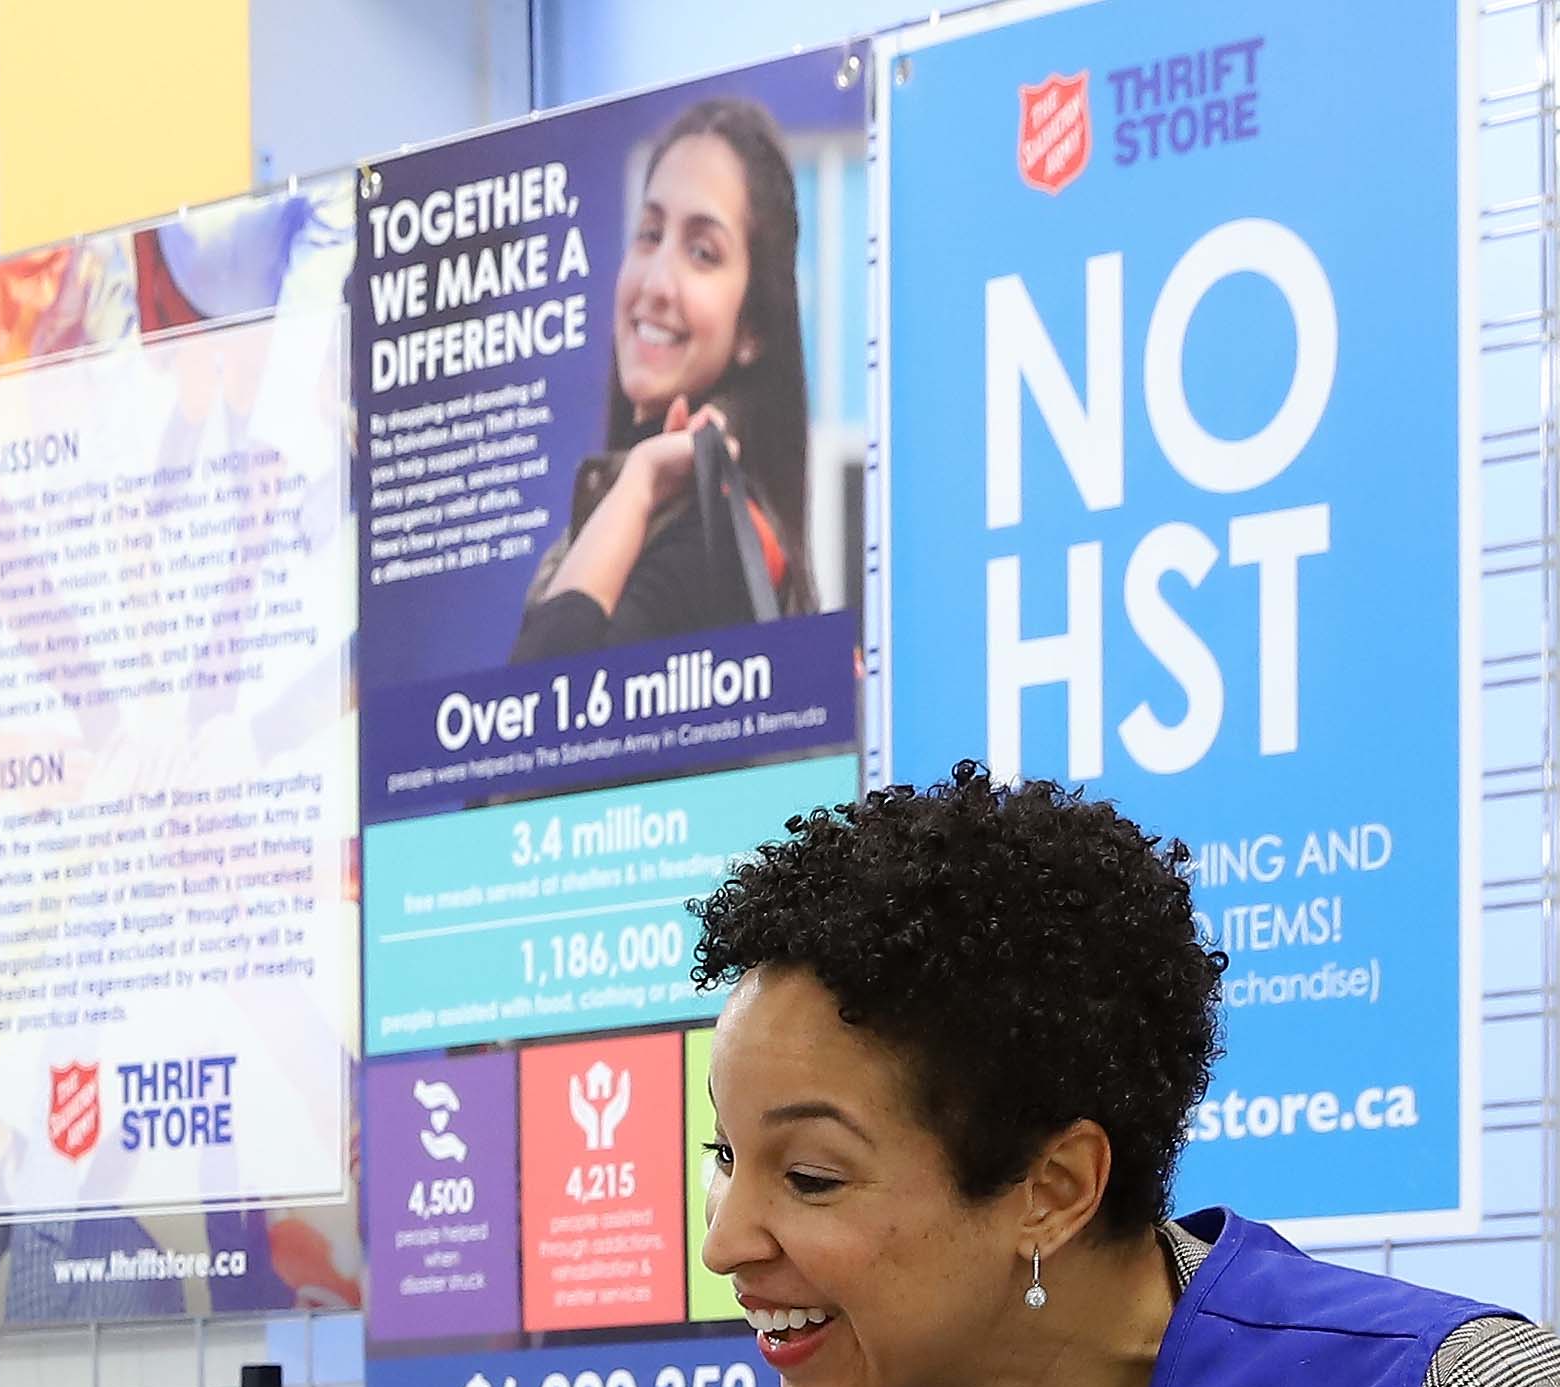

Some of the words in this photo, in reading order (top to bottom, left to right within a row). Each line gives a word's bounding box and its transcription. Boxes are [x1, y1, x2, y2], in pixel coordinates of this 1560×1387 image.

[1107, 36, 1264, 115] THRIFT
[1114, 92, 1261, 166] STORE
[369, 161, 579, 258] TOGETHER,
[370, 263, 428, 325] WE
[435, 236, 548, 311] MAKE
[558, 226, 589, 281] A
[370, 293, 587, 392] DIFFERENCE
[986, 217, 1338, 529] NO
[986, 502, 1330, 786] HST
[437, 686, 540, 752] Over
[551, 670, 613, 734] 1.6
[625, 652, 771, 721] million
[561, 735, 621, 766] Salvation
[623, 731, 662, 760] Army
[677, 716, 739, 747] Canada
[511, 817, 562, 868] 3.4
[572, 805, 688, 859] million
[1296, 823, 1392, 878] AND
[520, 920, 683, 986] 1,186,000
[1222, 896, 1342, 952] ITEMS!
[1221, 957, 1380, 1009] chandise)
[117, 1056, 236, 1105] THRIFT
[121, 1102, 233, 1152] STORE
[1189, 1083, 1418, 1142] store.ca
[408, 1175, 475, 1220] 4,500
[566, 1162, 637, 1205] 4,215
